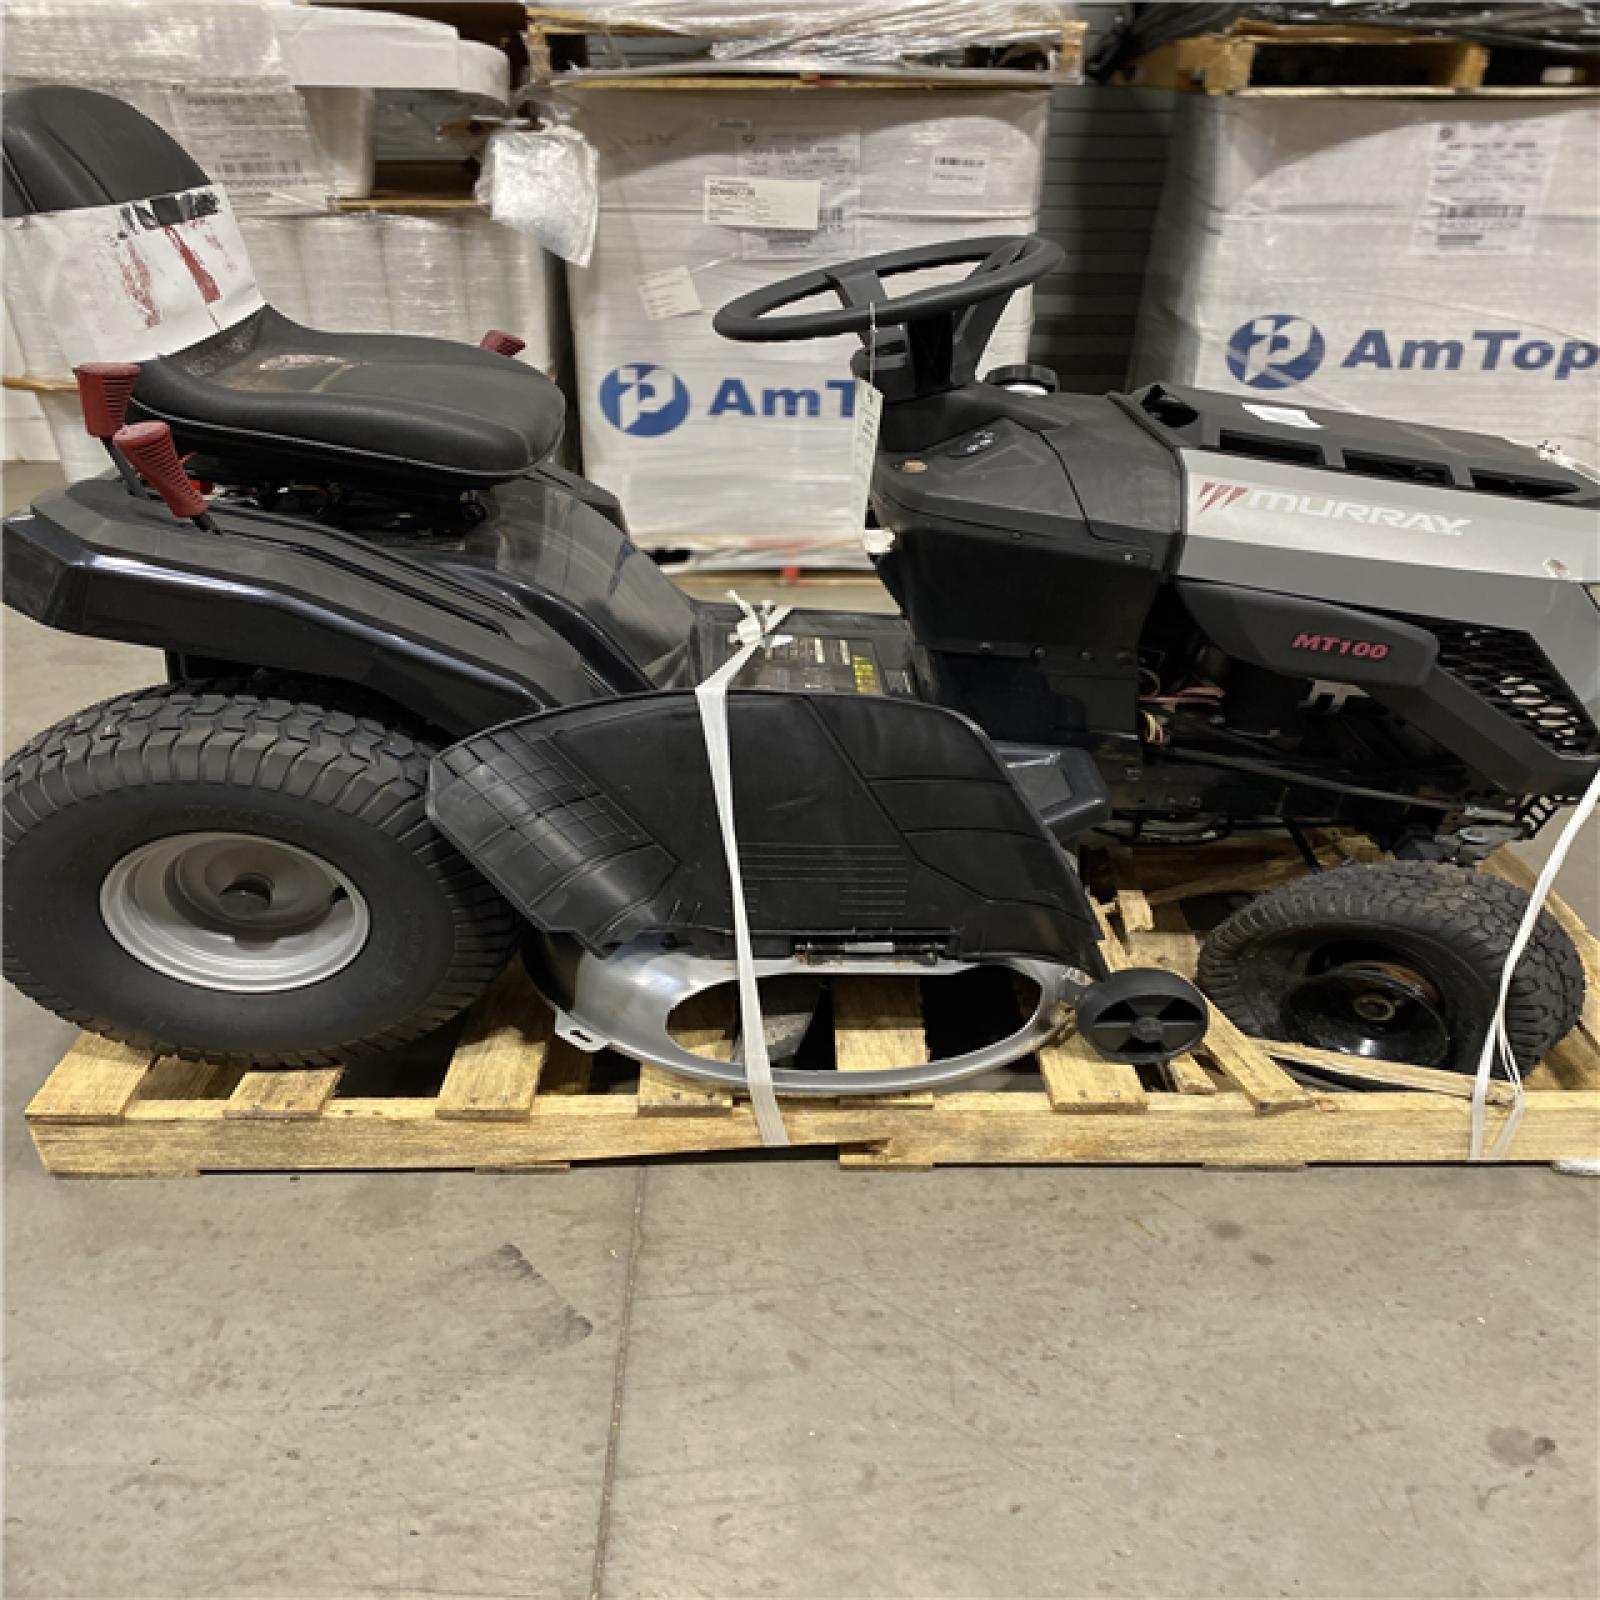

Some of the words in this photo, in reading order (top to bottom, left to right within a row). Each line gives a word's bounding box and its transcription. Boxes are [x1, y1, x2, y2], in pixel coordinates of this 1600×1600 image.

[1340, 328, 1599, 381] AmTop
[1248, 489, 1472, 536] MURRAY
[1292, 632, 1388, 659] MT100
